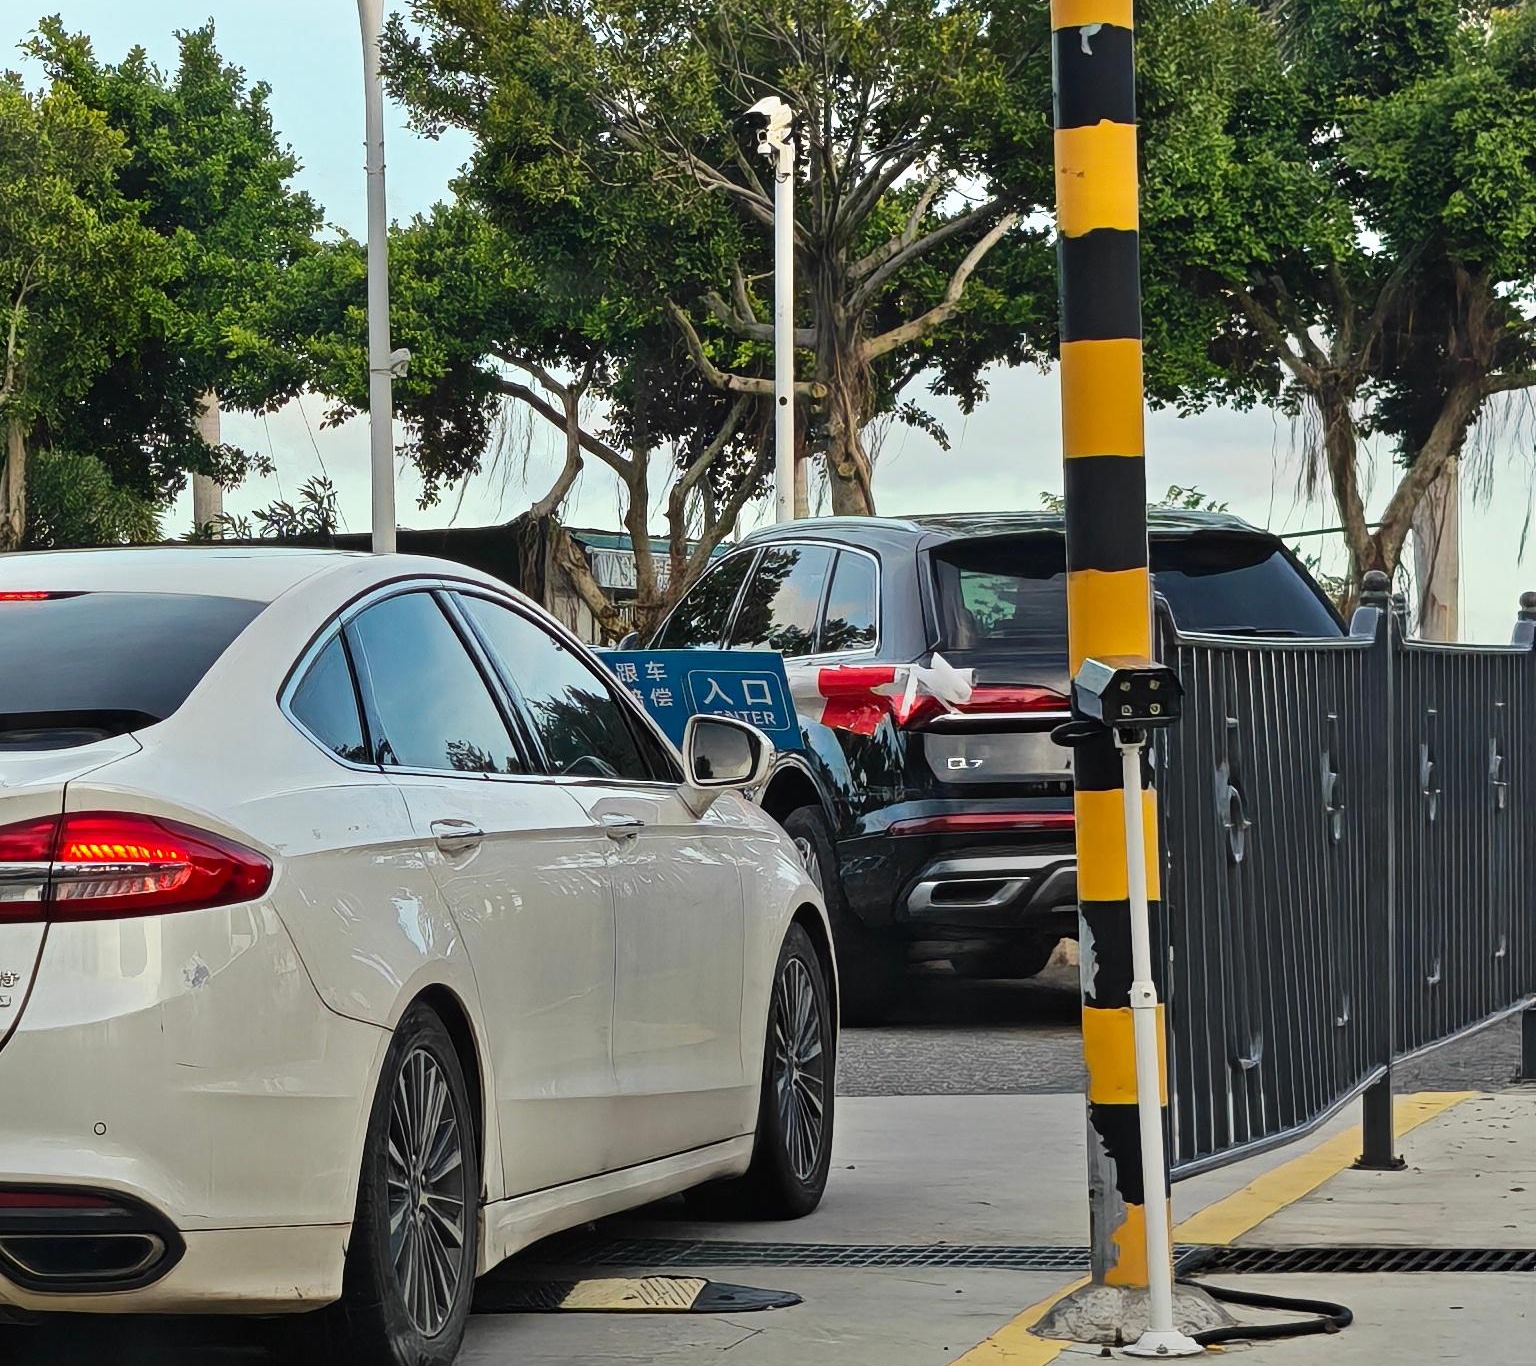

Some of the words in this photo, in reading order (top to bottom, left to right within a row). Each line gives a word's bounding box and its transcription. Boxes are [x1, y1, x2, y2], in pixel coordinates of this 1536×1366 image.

[615, 660, 668, 683] 跟车
[703, 678, 773, 706] 入口
[947, 757, 983, 769] Q7
